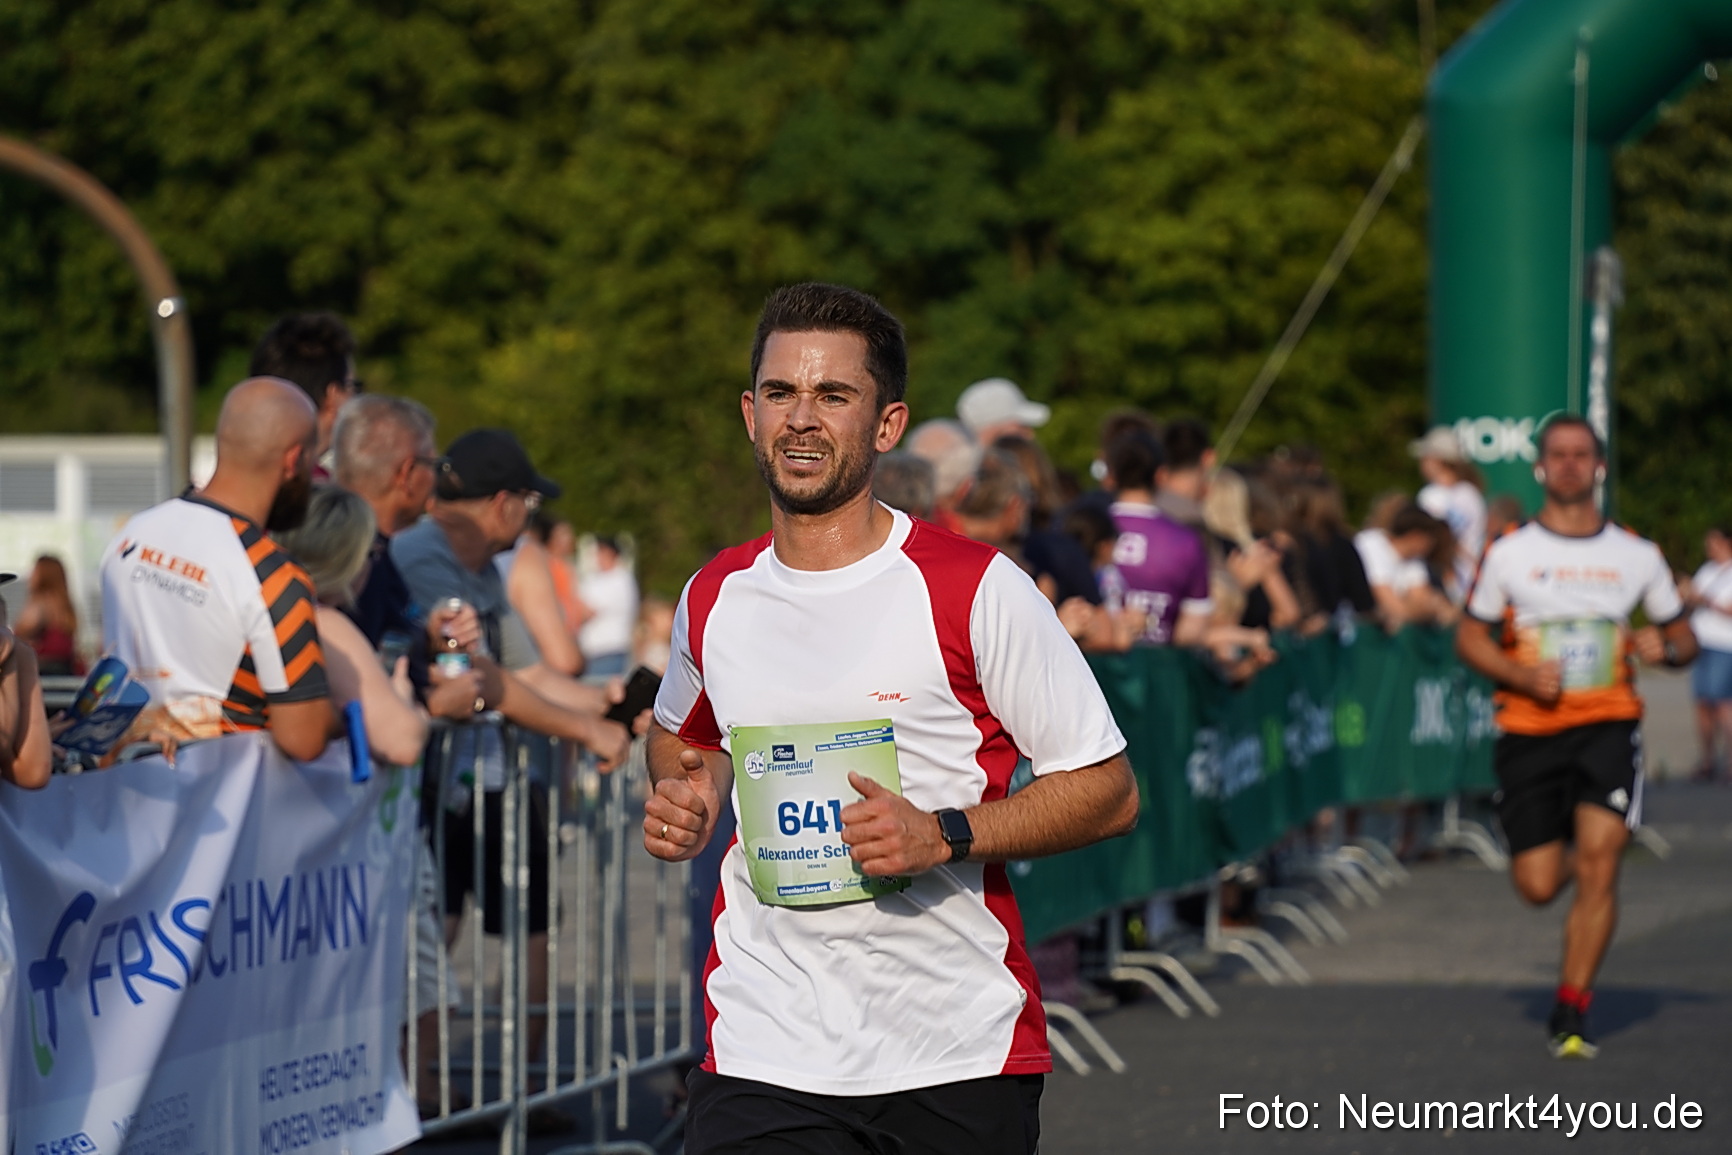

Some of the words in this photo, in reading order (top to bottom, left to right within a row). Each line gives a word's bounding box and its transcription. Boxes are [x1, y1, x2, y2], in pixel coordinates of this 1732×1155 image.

[139, 546, 210, 588] KLEBL
[877, 692, 902, 702] DEHN
[767, 758, 814, 773] Firmenlauf
[785, 768, 814, 777] neumarkt
[777, 799, 844, 836] 641
[757, 846, 820, 861] Alexander
[88, 861, 371, 1018] FRISCHMANN
[258, 1110, 320, 1155] MORGEN
